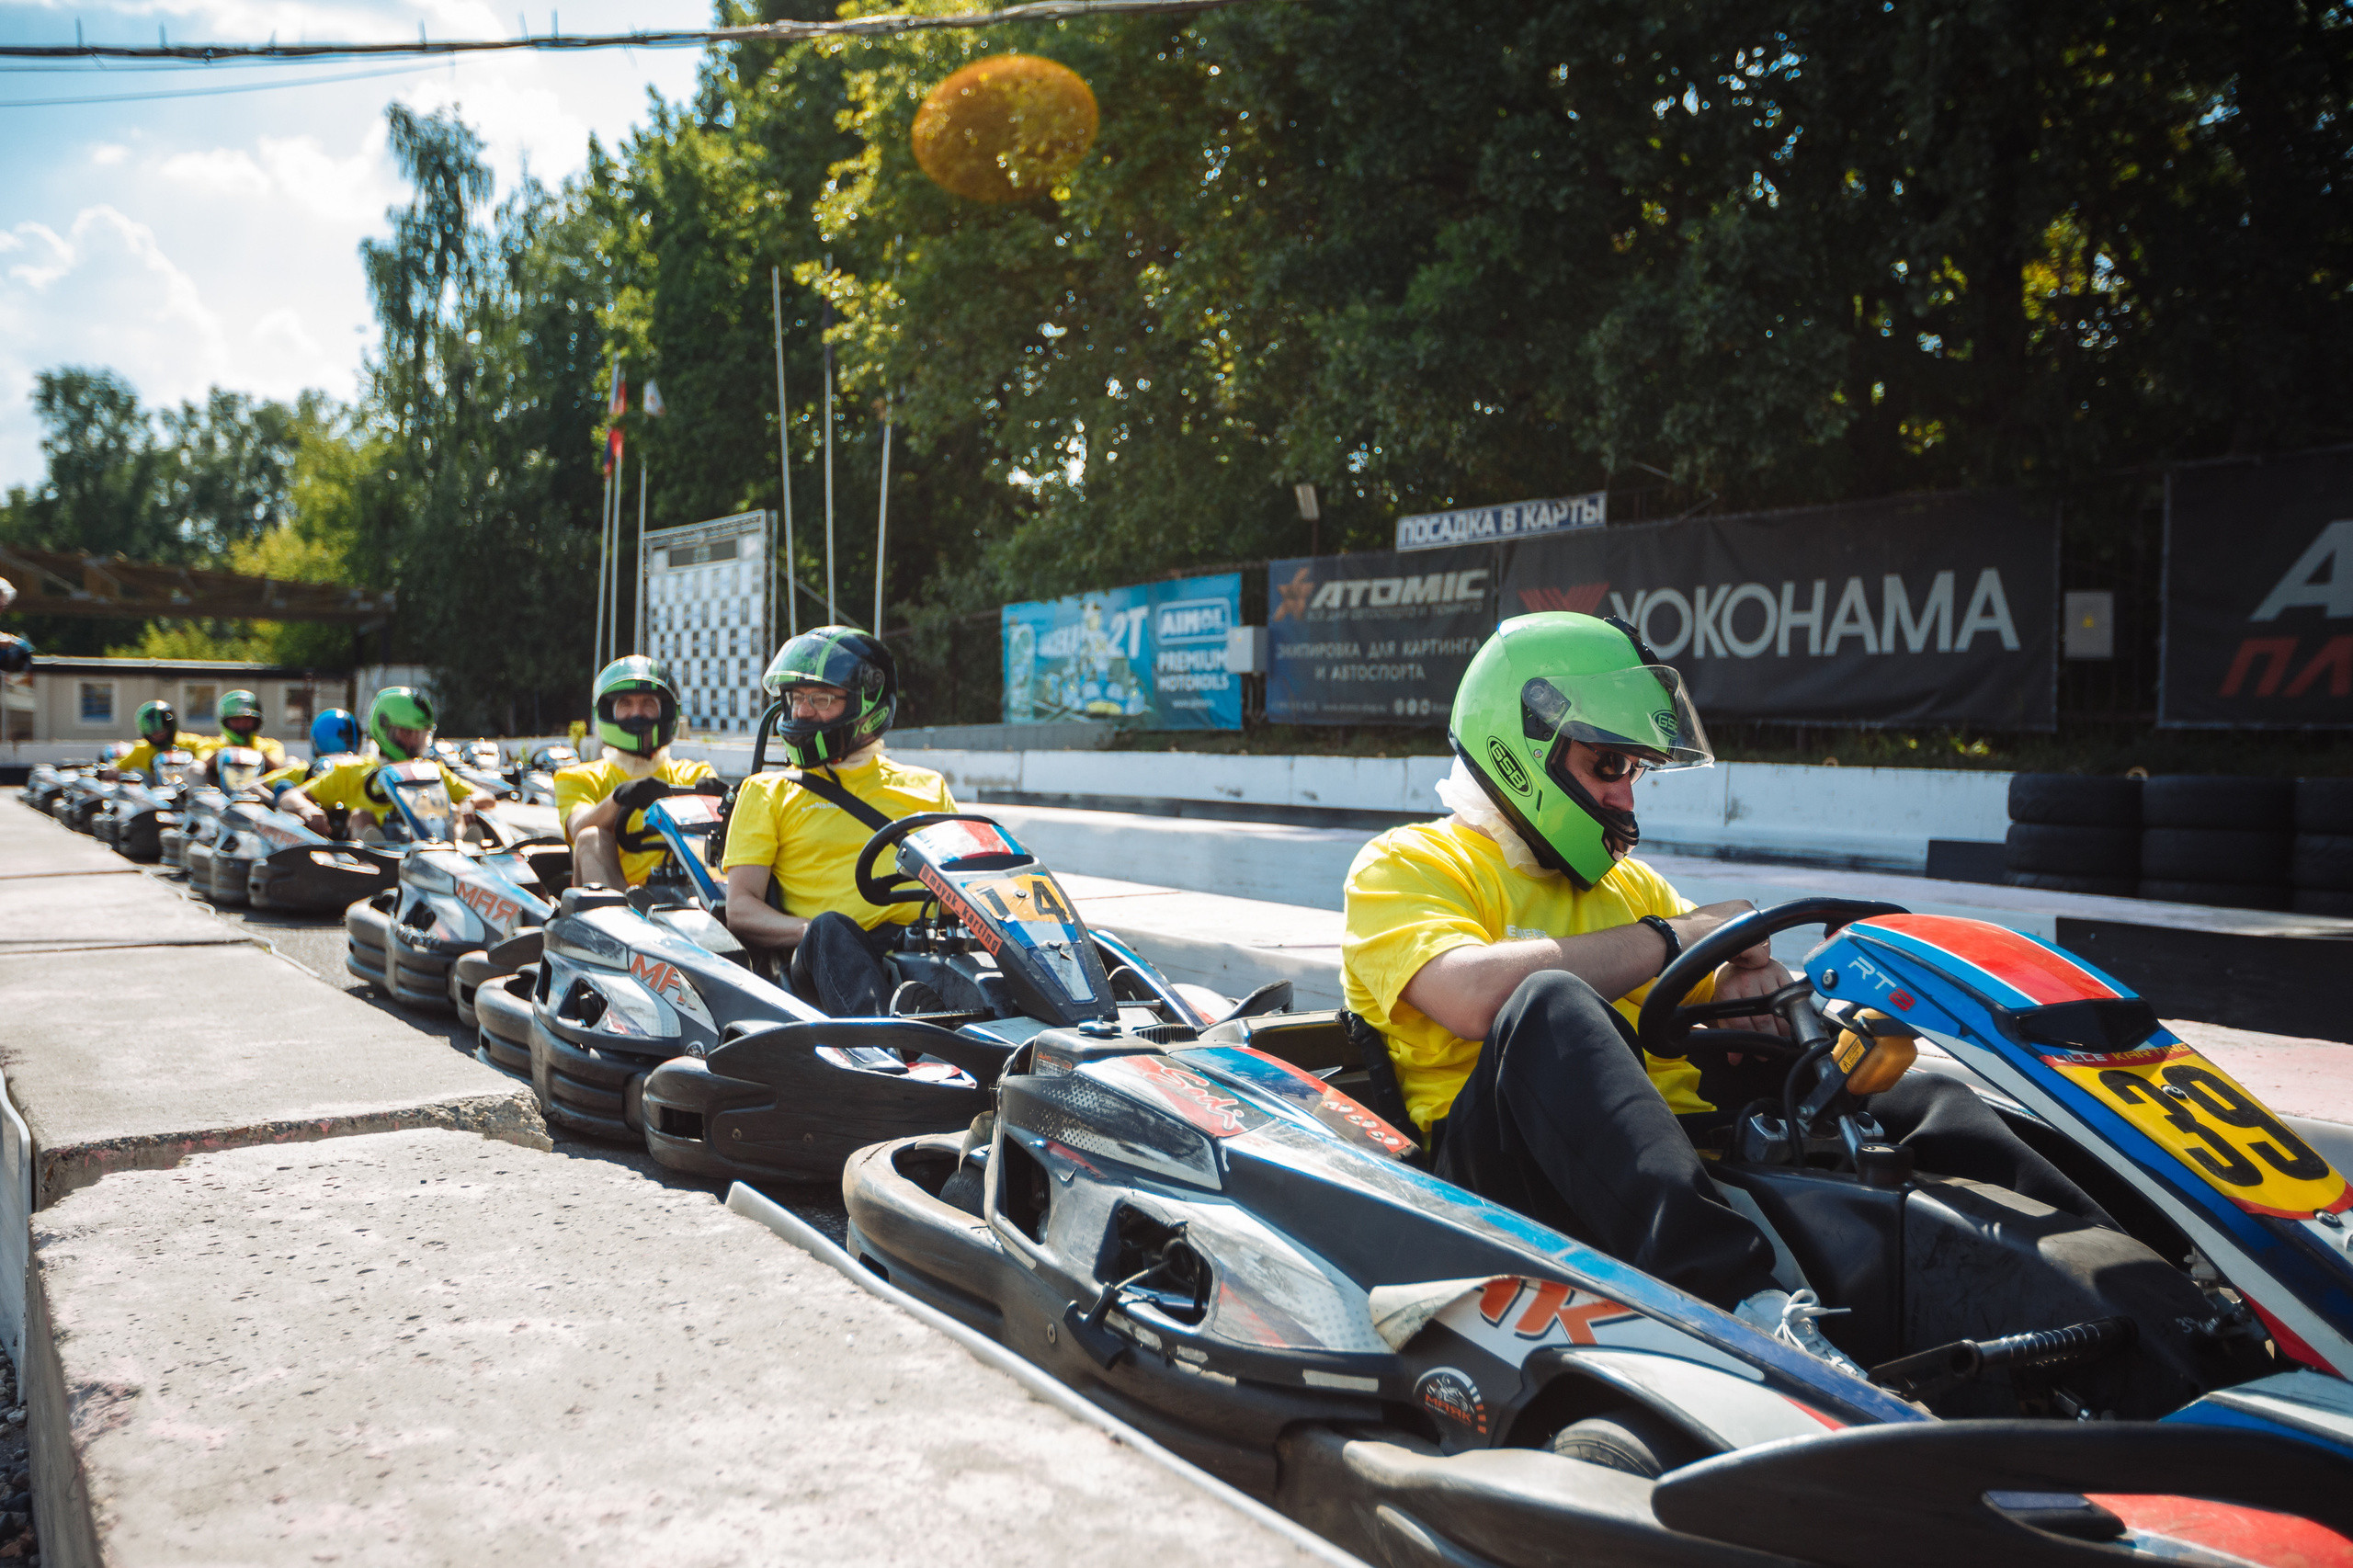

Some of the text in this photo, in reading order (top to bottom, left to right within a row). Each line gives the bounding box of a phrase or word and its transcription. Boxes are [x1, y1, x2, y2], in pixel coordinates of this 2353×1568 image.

[1399, 495, 1606, 545] ПОСАДКА В КАРТЫ
[1310, 569, 1489, 610] ATOMIC
[1608, 568, 2021, 659] YOKOHAMA
[1157, 649, 1230, 673] PREMIUM
[1314, 664, 1426, 681] И АВТОСПОРТА
[1367, 641, 1395, 659] ДЛЯ
[1401, 638, 1482, 656] КАРТИНГА
[1490, 744, 1528, 790] GSB
[921, 867, 999, 951] @mayak_karting
[1847, 956, 1915, 1012] RT8
[2052, 1042, 2191, 1063] LILLE KARTING
[1142, 1066, 1245, 1131] Sodi
[2097, 1064, 2331, 1187] 39
